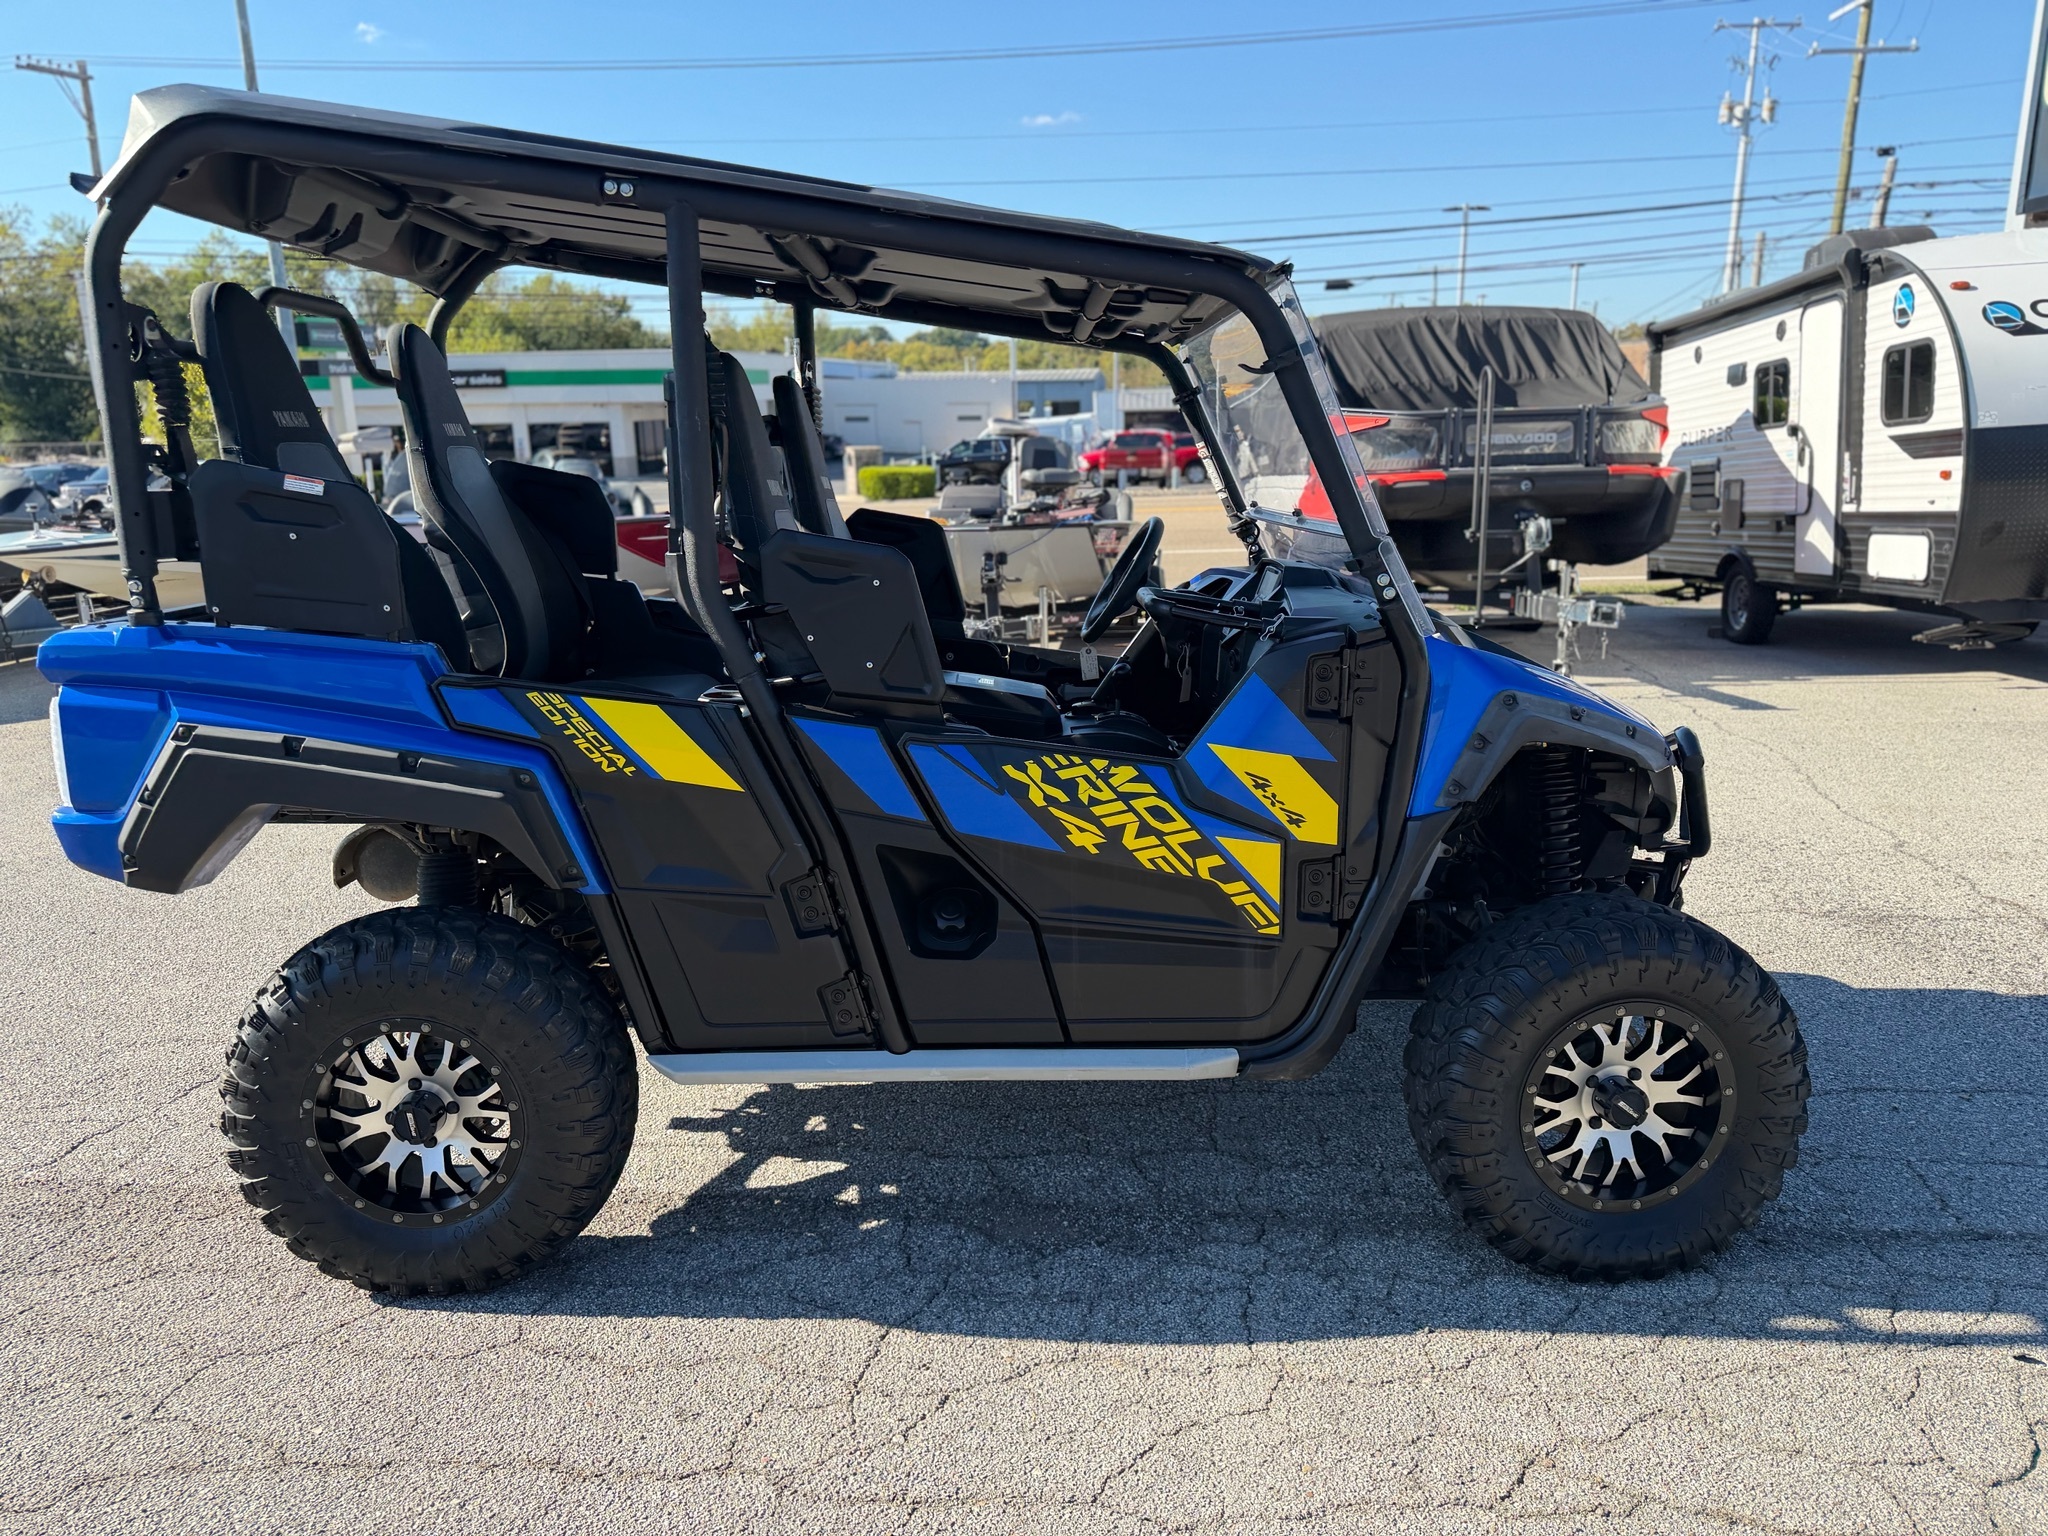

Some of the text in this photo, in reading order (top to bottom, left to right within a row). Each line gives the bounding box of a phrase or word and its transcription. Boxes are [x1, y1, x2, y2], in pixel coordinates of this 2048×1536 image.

[469, 373, 503, 386] sales
[1681, 426, 1733, 446] CLIPPER
[526, 691, 617, 773] EDITION
[543, 692, 636, 777] SPECIAL
[1002, 760, 1107, 855] X4
